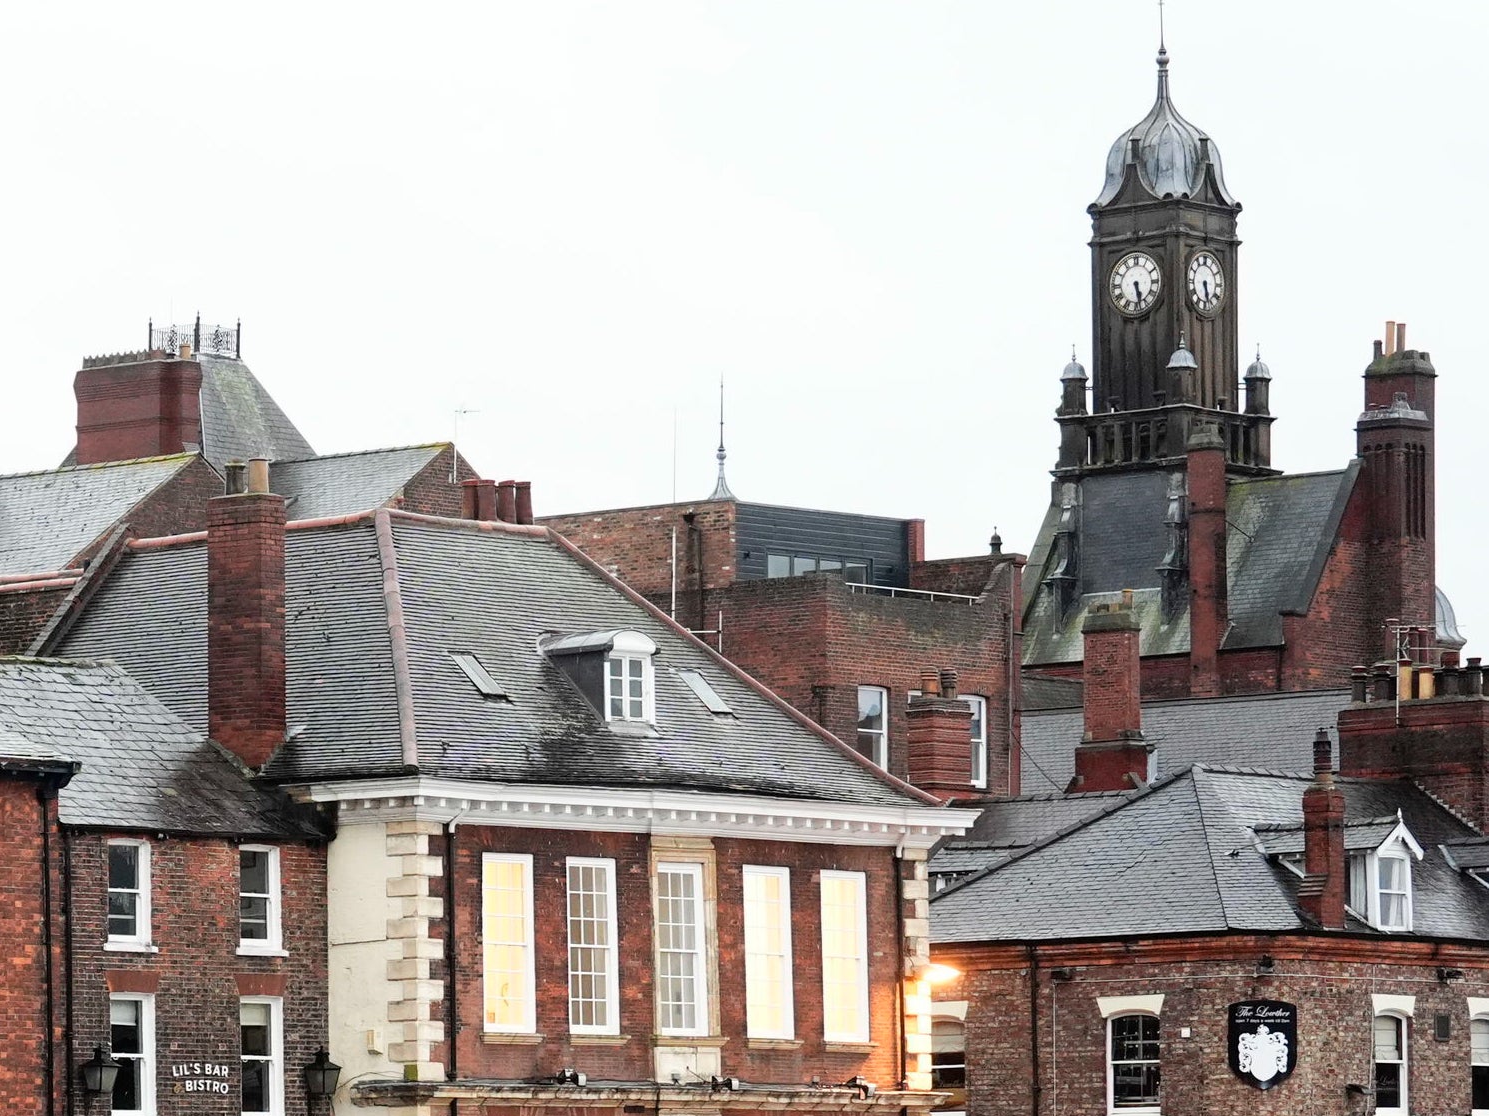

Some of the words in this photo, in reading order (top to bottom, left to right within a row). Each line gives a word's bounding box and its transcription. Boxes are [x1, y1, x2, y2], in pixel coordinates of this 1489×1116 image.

[172, 1063, 201, 1077] LIL'S
[205, 1064, 229, 1077] BAR
[185, 1080, 229, 1094] BISTRO
